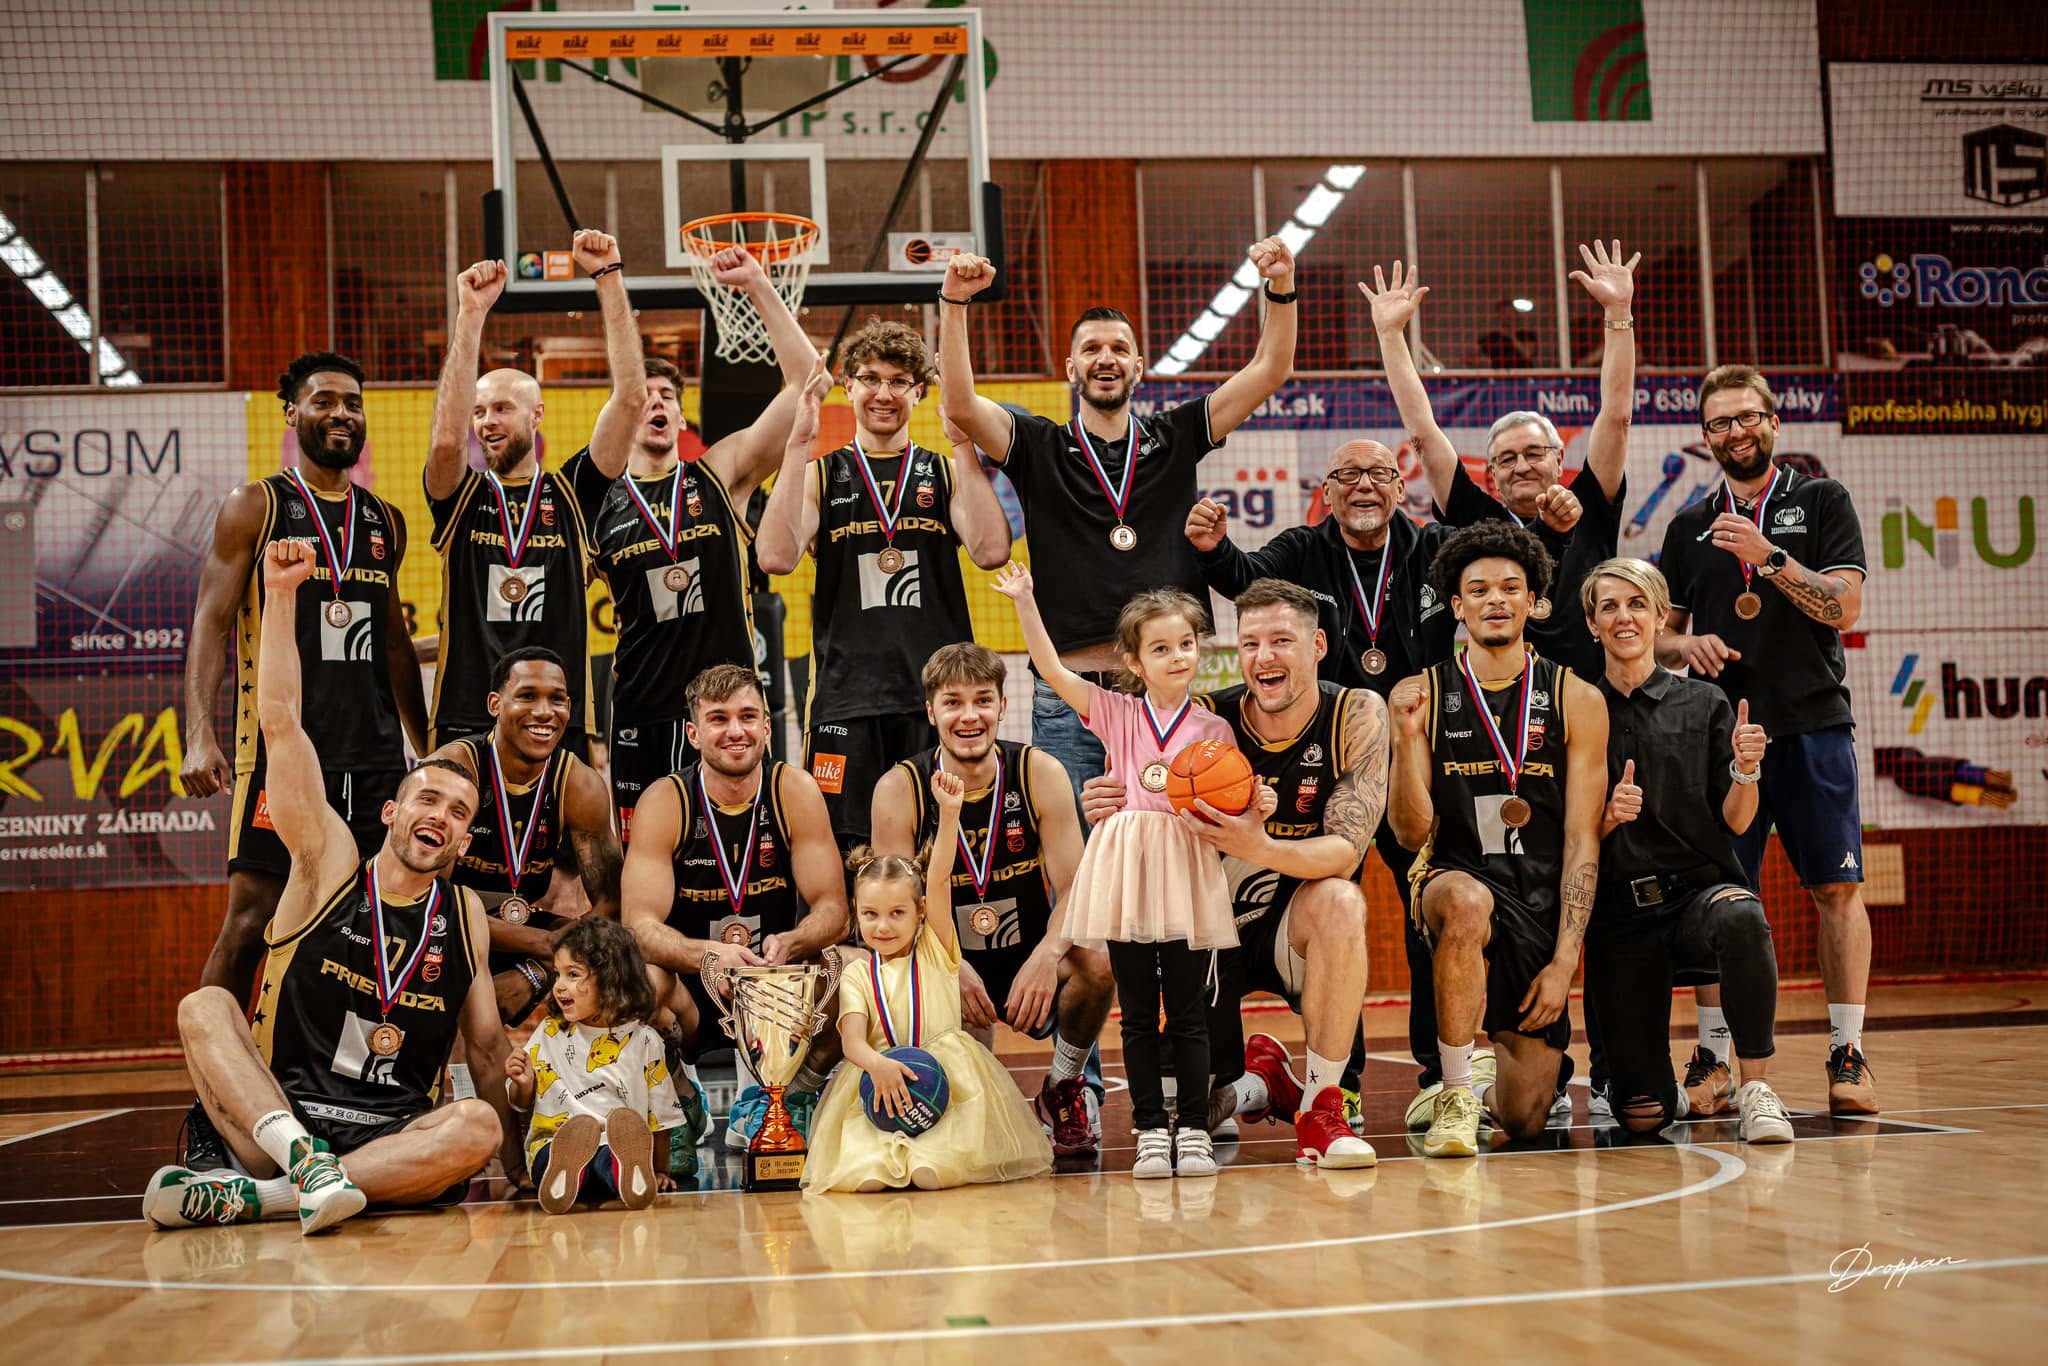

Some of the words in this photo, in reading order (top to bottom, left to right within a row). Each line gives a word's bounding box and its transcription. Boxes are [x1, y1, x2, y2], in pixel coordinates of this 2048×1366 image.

[1538, 390, 1595, 412] Nám.
[1773, 391, 1824, 415] váky
[1850, 399, 1996, 428] profesionálna
[611, 522, 722, 567] PRIEIDZA
[70, 631, 126, 652] since
[132, 628, 185, 649] 1992
[814, 759, 841, 780] niké
[97, 807, 216, 835] ZÁHRADA
